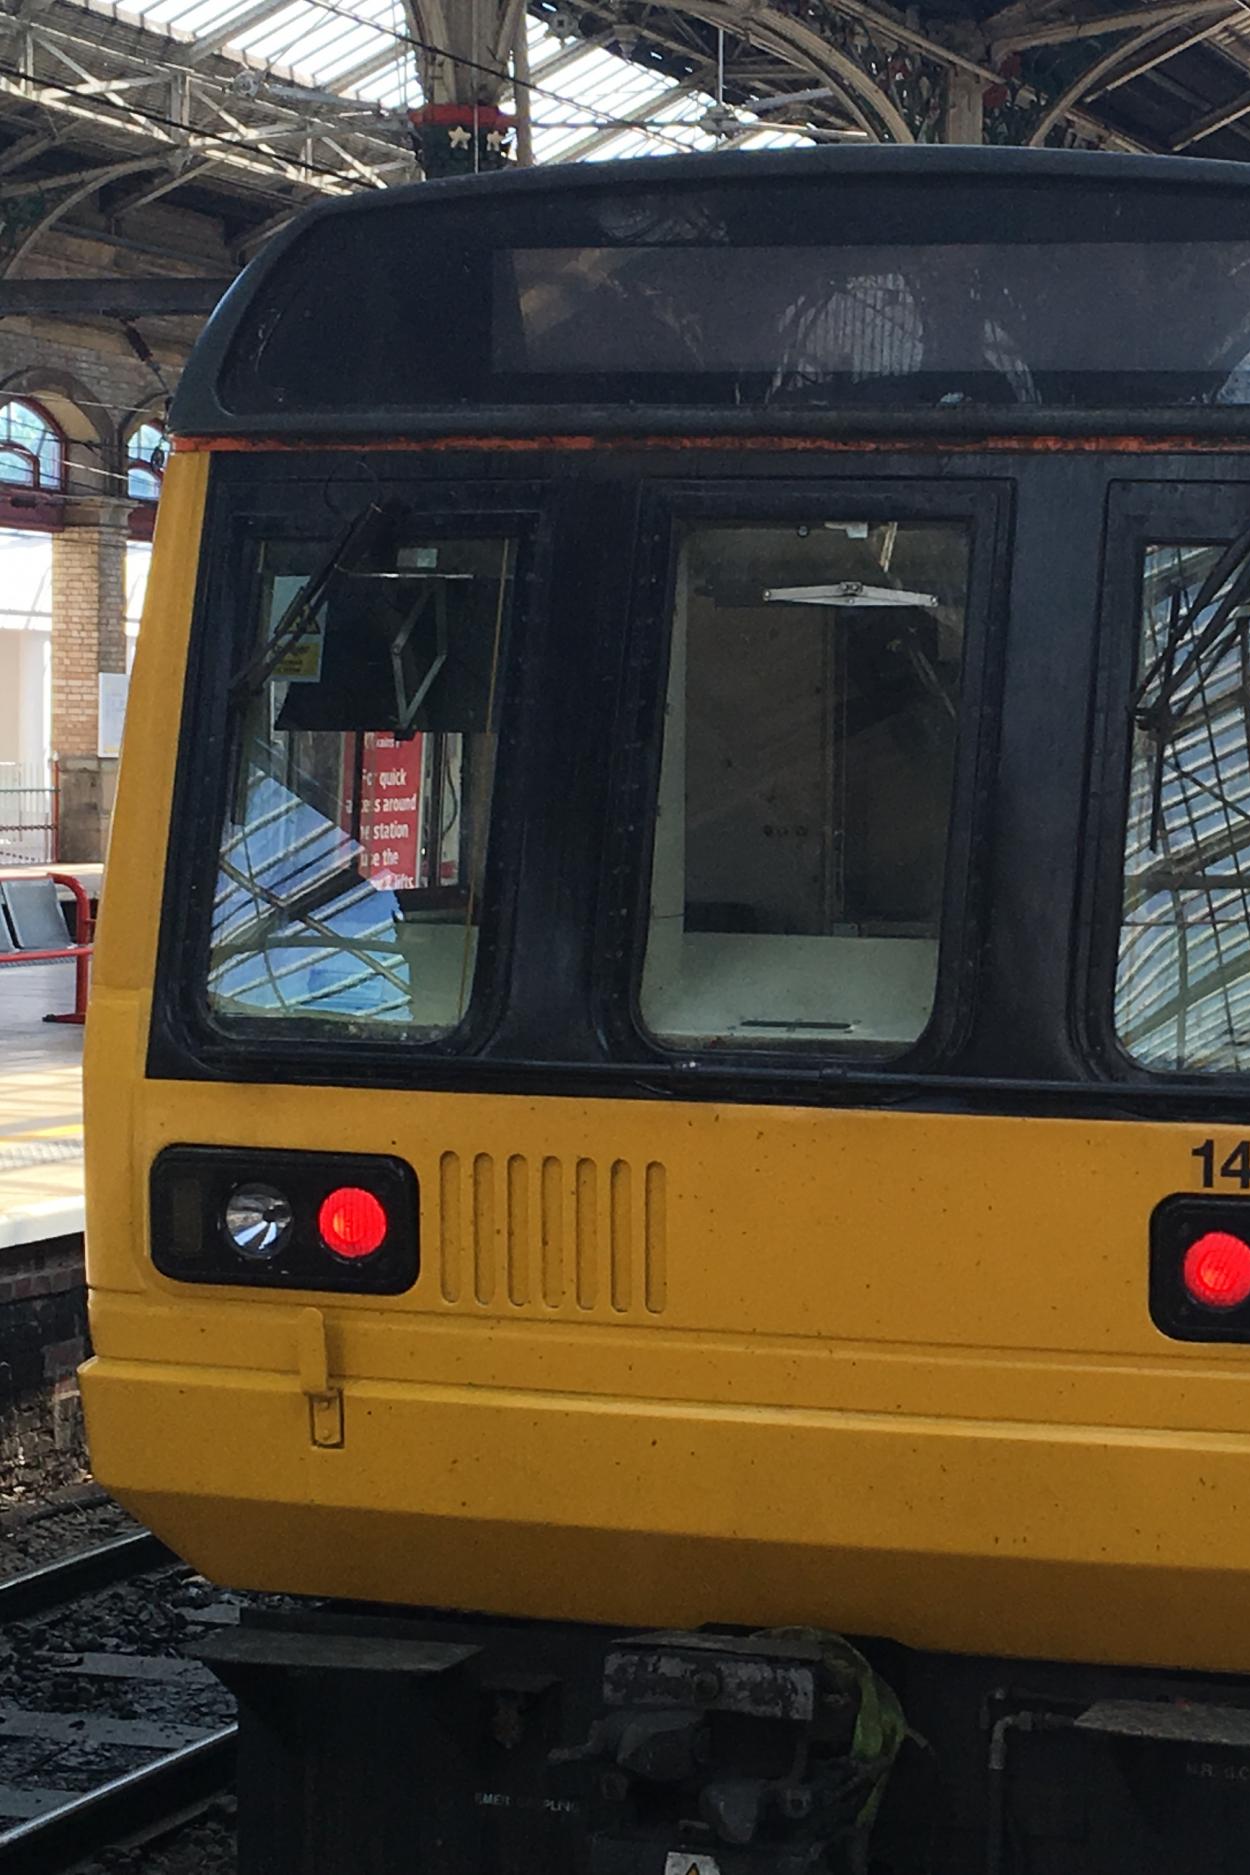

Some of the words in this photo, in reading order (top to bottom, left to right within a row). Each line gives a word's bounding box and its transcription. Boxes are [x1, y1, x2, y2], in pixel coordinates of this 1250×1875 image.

[379, 768, 407, 790] quick
[383, 793, 417, 812] around
[373, 820, 409, 840] station
[382, 848, 400, 866] the
